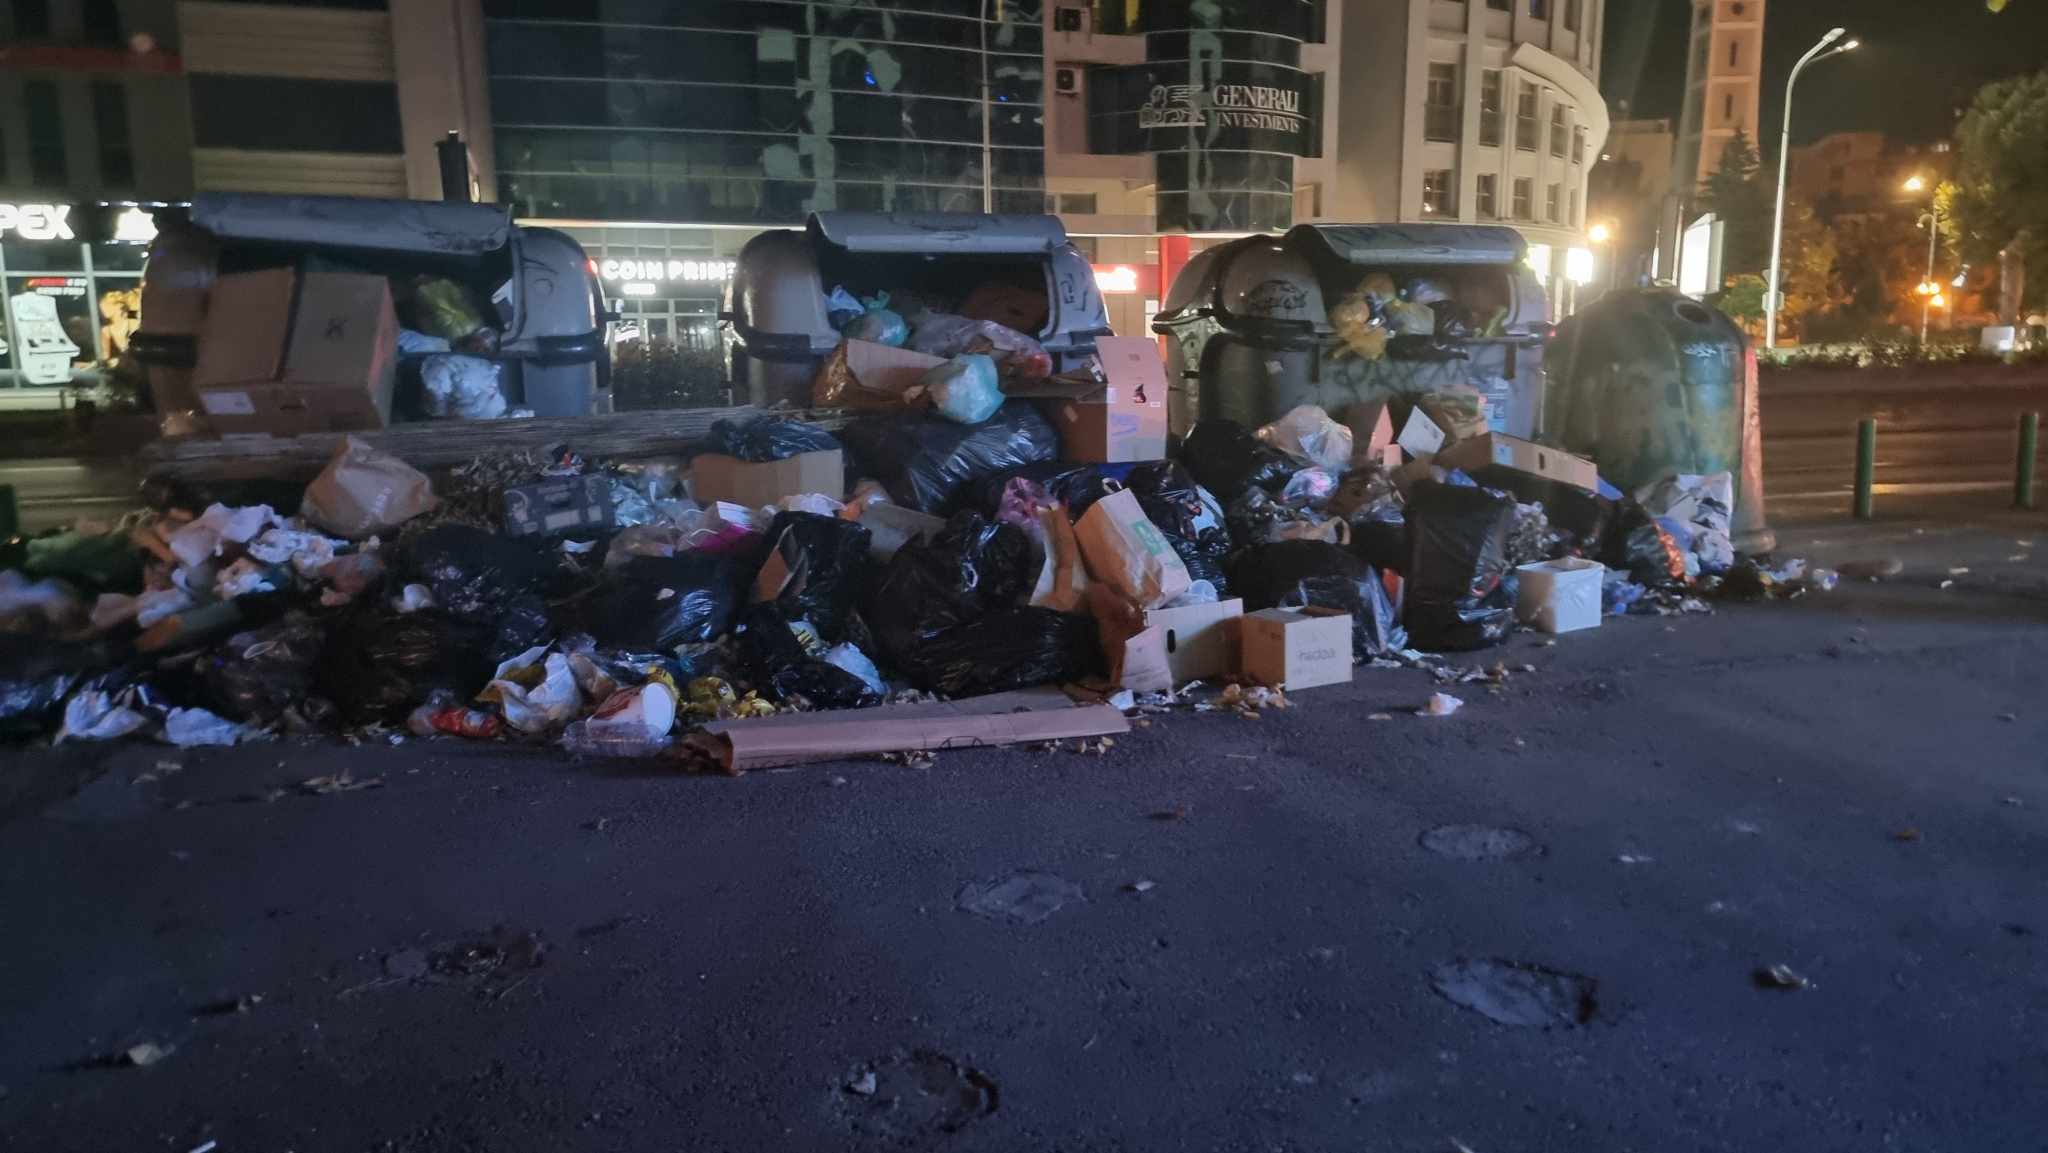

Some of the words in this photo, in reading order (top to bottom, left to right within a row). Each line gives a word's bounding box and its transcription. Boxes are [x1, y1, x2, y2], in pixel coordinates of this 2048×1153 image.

[1213, 84, 1299, 113] GENERALI
[1216, 112, 1300, 134] INVESTMENTS
[602, 259, 664, 281] COIN
